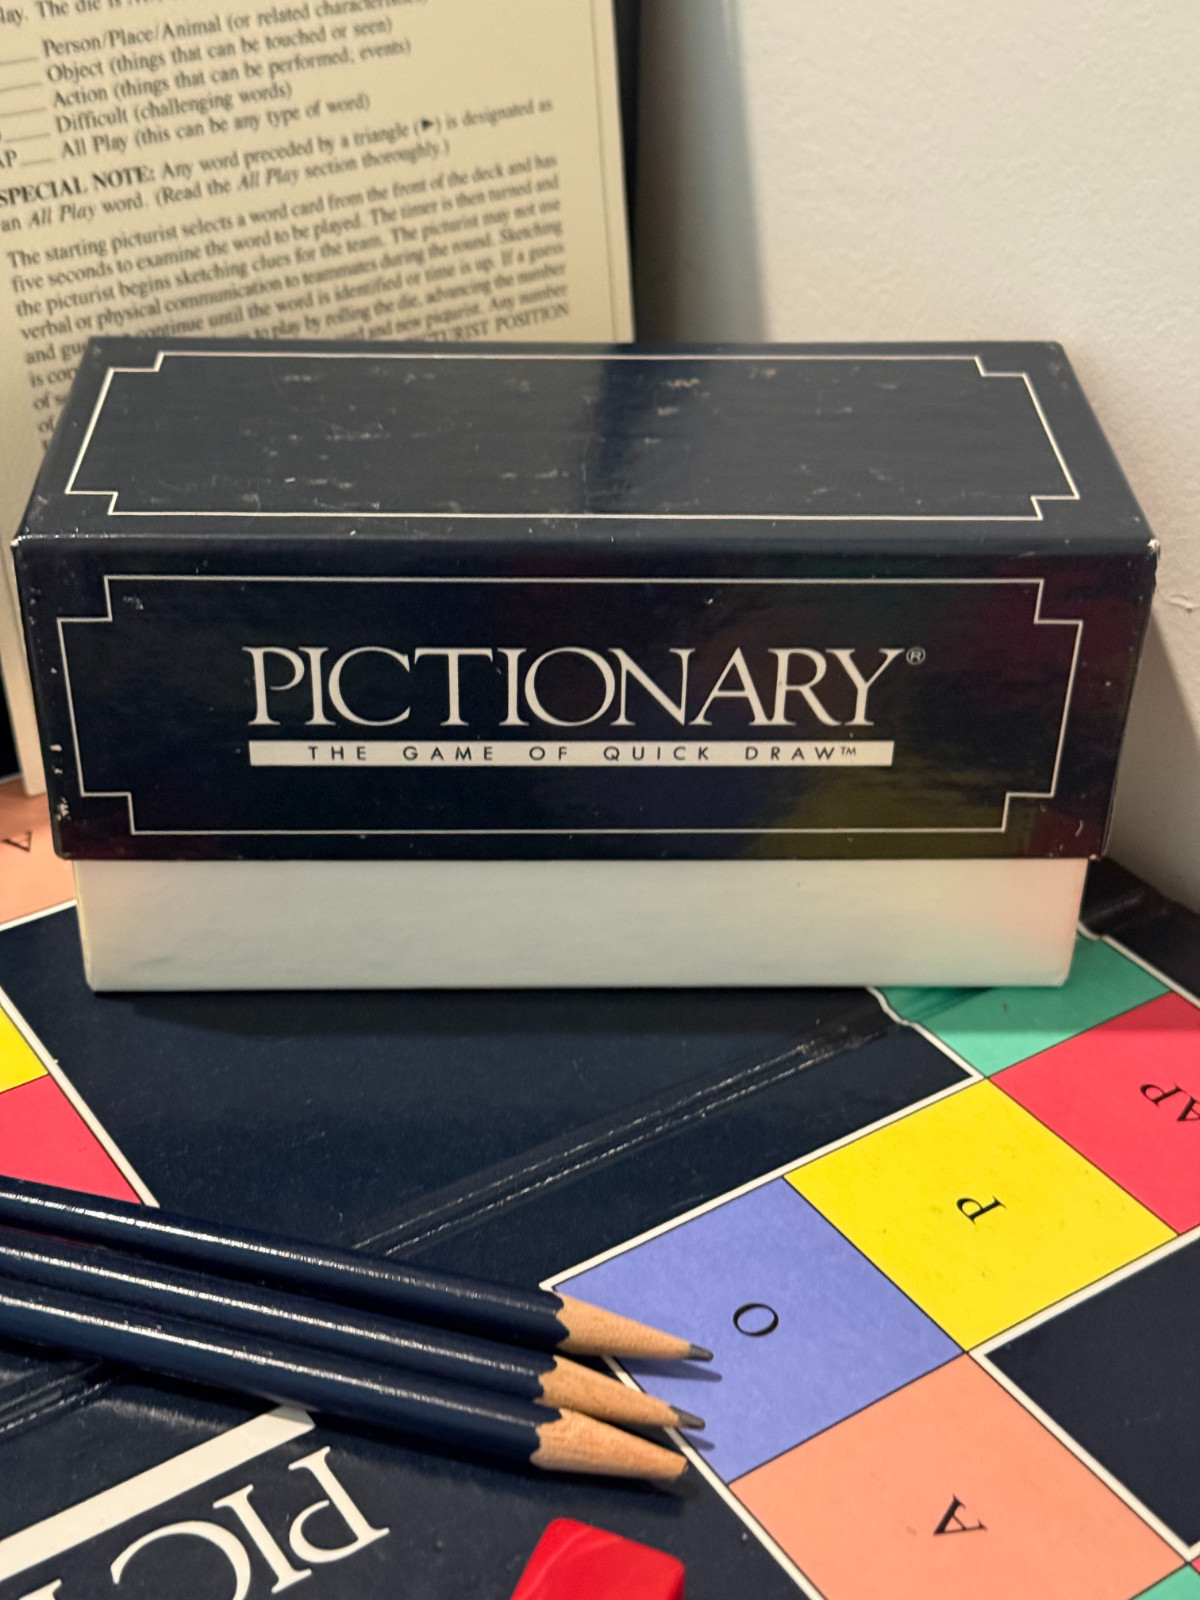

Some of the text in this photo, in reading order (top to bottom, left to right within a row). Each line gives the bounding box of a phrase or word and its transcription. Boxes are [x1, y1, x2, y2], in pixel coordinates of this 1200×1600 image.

[35, 0, 69, 18] The
[75, 0, 101, 13] die
[41, 13, 222, 58] Person/Place/Animal
[226, 12, 250, 32] (or
[256, 4, 310, 27] related
[46, 15, 393, 84] Object (things that can be touched or seen)
[53, 87, 108, 108] Action
[113, 79, 170, 100] (things
[174, 70, 205, 89] that
[209, 67, 240, 84] can
[243, 61, 263, 79] be
[359, 36, 411, 61] events)
[54, 80, 293, 134] Difficult (challenging words)
[61, 137, 87, 159] All
[91, 134, 127, 153] Play
[135, 125, 170, 150] (this
[174, 123, 204, 139] can
[208, 117, 229, 133] be
[233, 114, 259, 132] any
[266, 108, 300, 127] type
[305, 99, 321, 119] of
[326, 91, 370, 113] word)
[0, 98, 553, 208] SPECIAL NOTE: Any word preceded by a triangle is designated as
[1, 139, 450, 233] an All Play word. (Read the All Play section thoroughly.)
[6, 154, 559, 269] The starting picturist selects a word card from the front of the deck and has
[11, 172, 560, 294] five seconds to examine the word to be played. The timer is then turned and
[16, 298, 43, 318] the
[45, 286, 116, 318] picturist
[117, 277, 172, 301] begins
[173, 261, 249, 288] sketching
[251, 252, 292, 273] clues
[294, 246, 316, 264] for
[319, 240, 343, 259] the
[390, 226, 419, 245] The
[421, 214, 479, 243] picturist
[481, 209, 510, 228] may
[512, 202, 536, 220] not
[20, 313, 73, 340] verbal
[75, 315, 93, 330] or
[95, 297, 161, 331] physical
[163, 278, 283, 314] communication
[283, 274, 300, 289] to
[301, 259, 378, 286] teammates
[426, 241, 449, 260] the
[494, 301, 569, 333] POSITION
[25, 342, 56, 365] and
[207, 305, 244, 328] until
[246, 302, 272, 320] the
[275, 290, 313, 311] word
[316, 288, 331, 306] is
[28, 368, 45, 388] is
[33, 390, 50, 411] of
[308, 745, 366, 761] THE
[402, 745, 493, 761] GAME
[529, 745, 568, 761] OF
[603, 745, 710, 762] QUICK
[956, 1195, 1007, 1225] P
[733, 1302, 779, 1338] O
[932, 1493, 989, 1537] A
